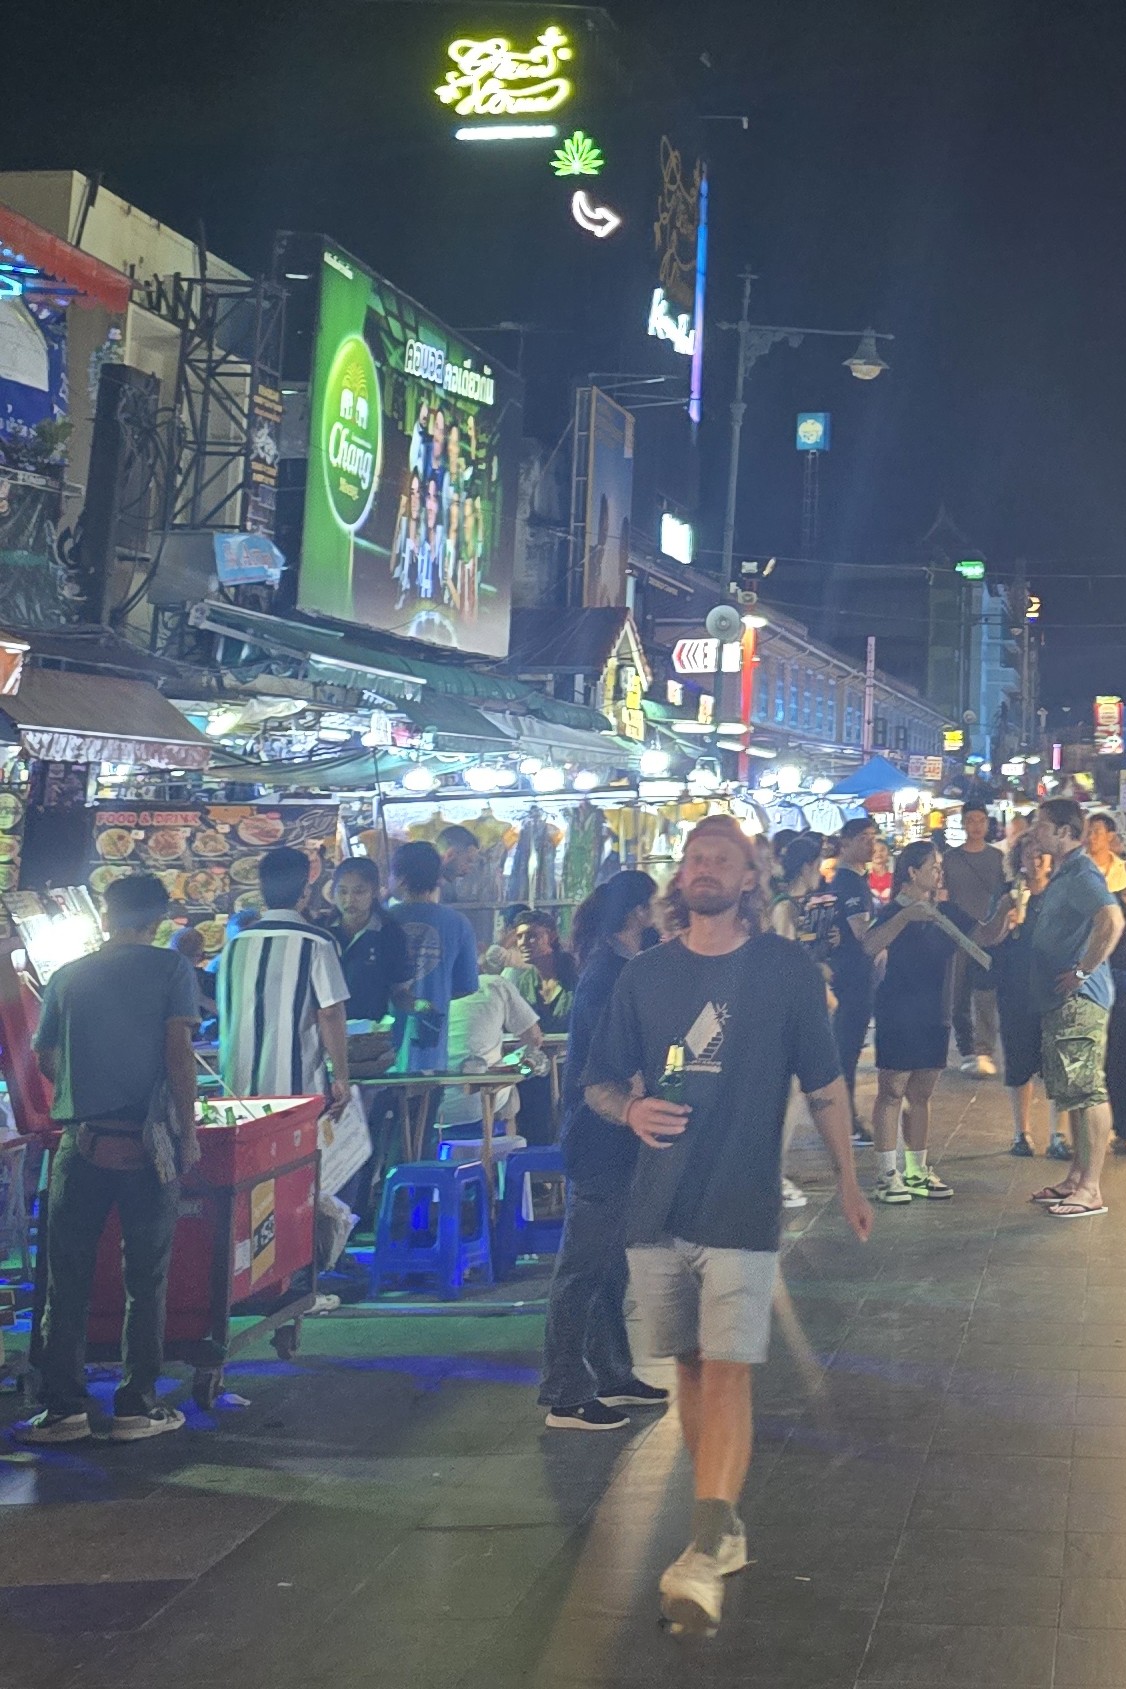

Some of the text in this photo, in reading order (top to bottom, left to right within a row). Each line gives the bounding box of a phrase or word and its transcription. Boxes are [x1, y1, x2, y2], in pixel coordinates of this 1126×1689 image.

[329, 421, 373, 490] Chang
[96, 811, 201, 826] FOOD & DRINK
